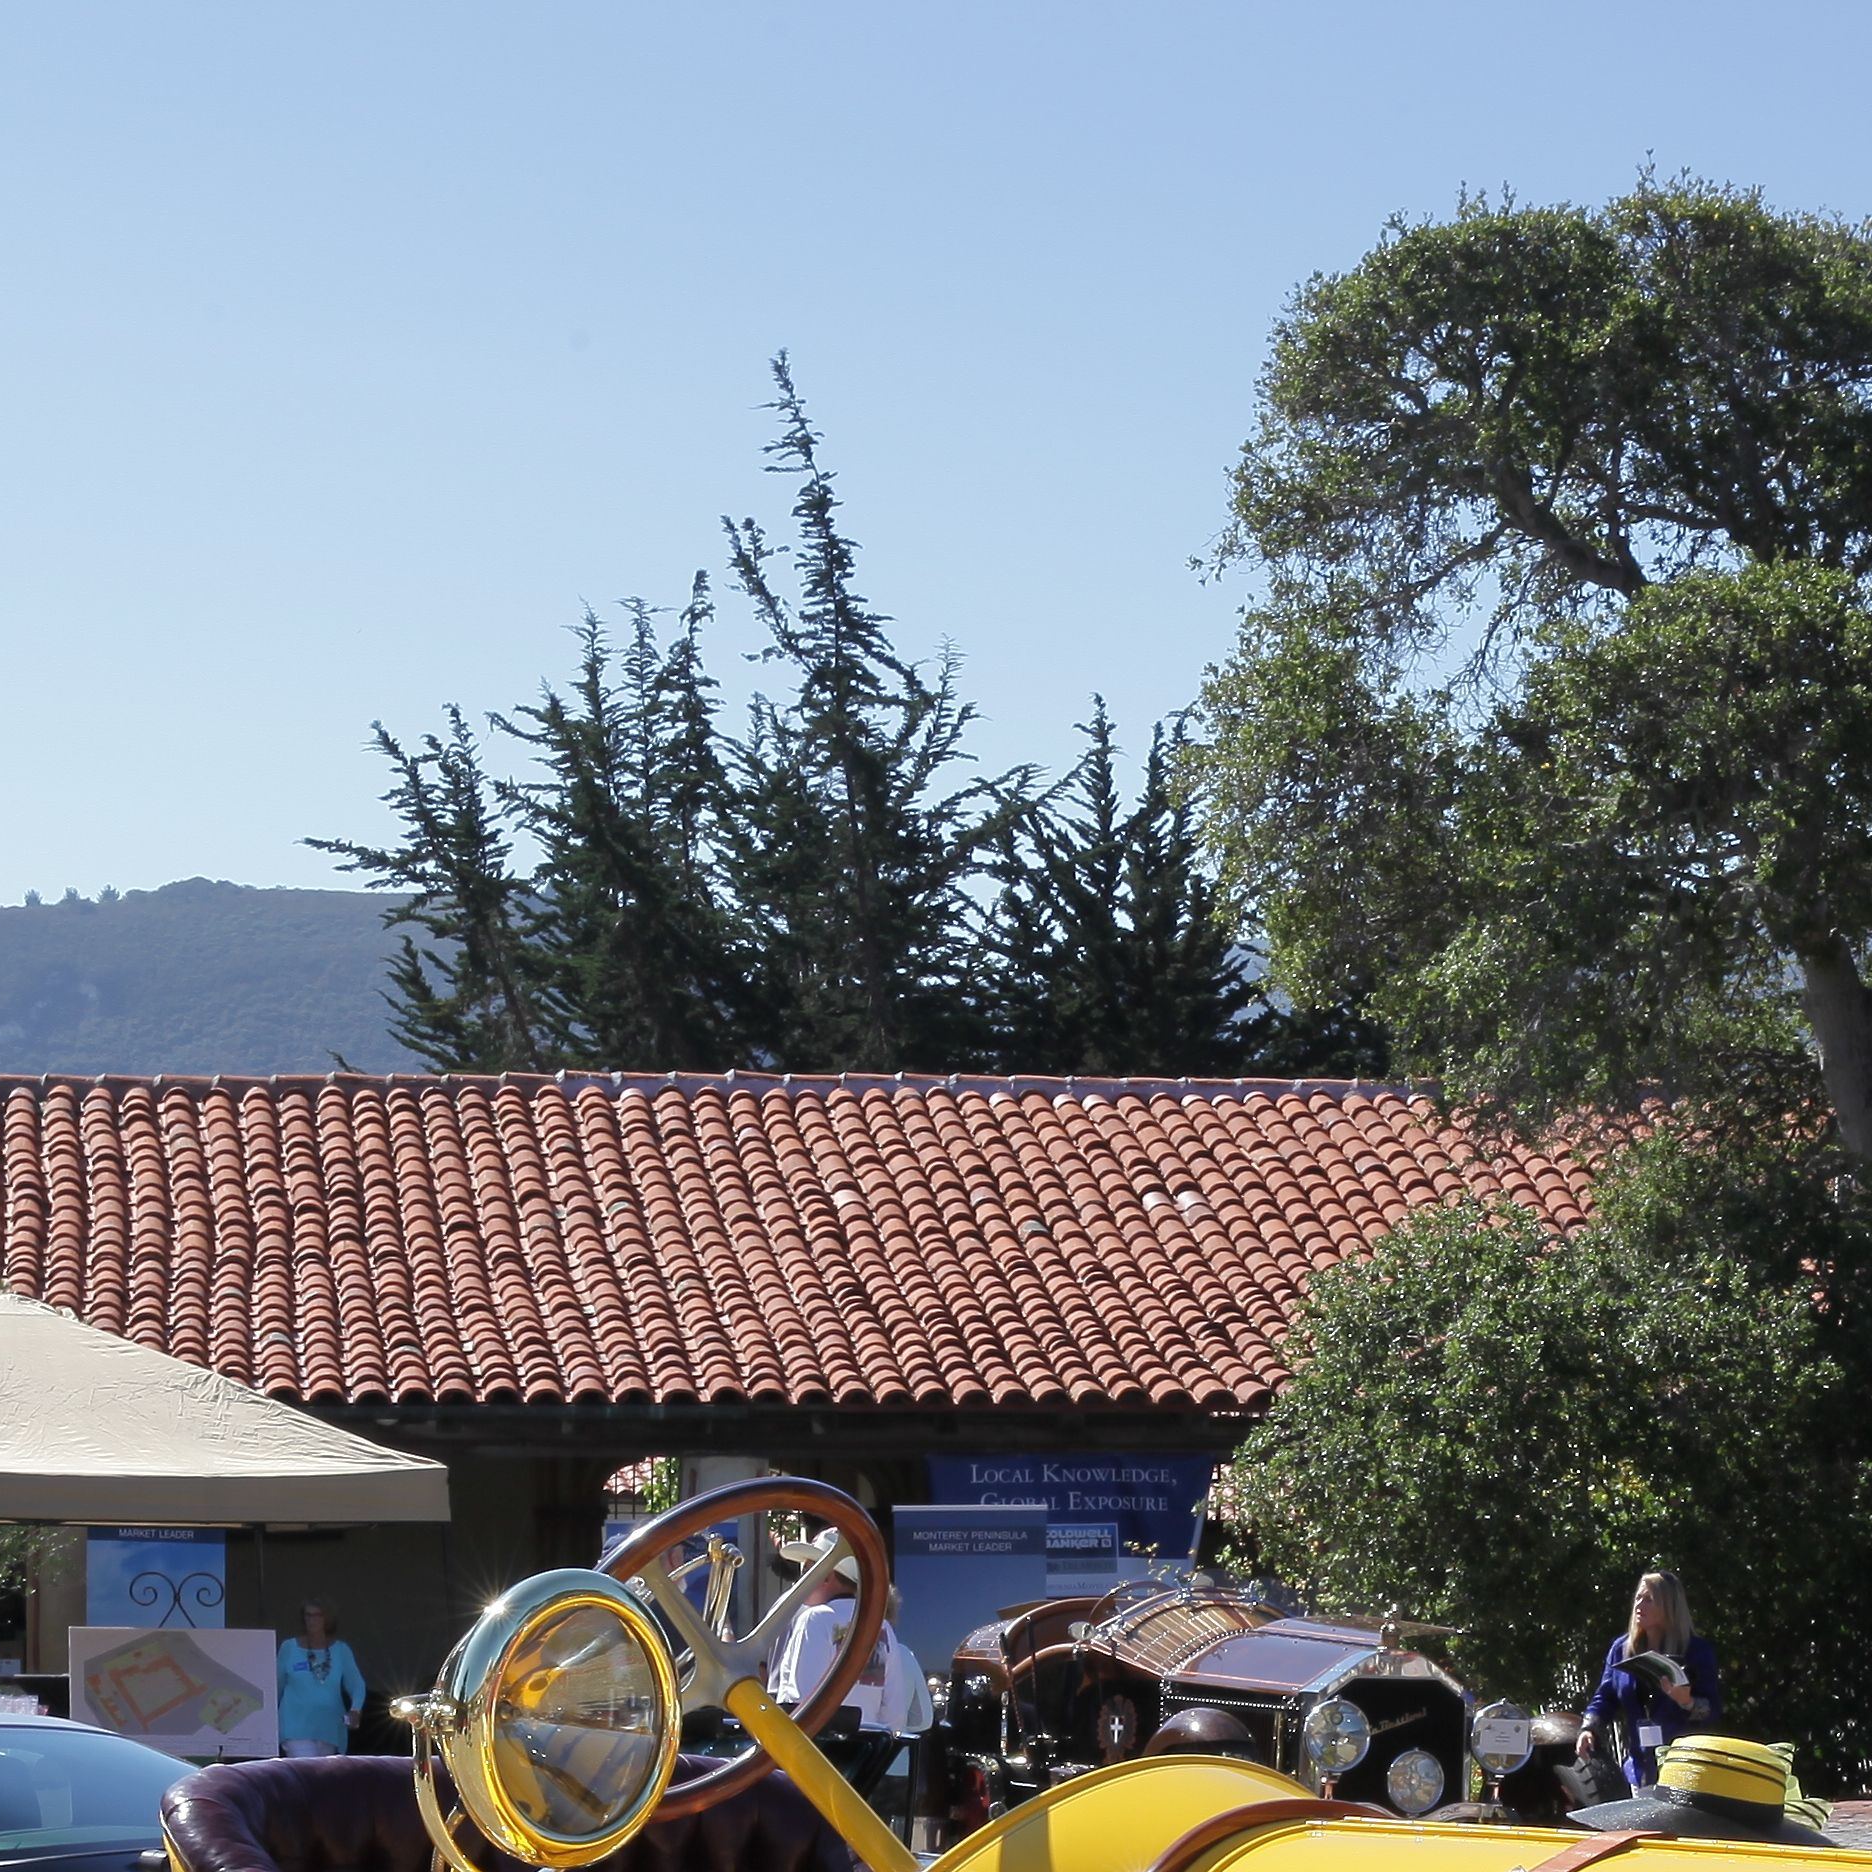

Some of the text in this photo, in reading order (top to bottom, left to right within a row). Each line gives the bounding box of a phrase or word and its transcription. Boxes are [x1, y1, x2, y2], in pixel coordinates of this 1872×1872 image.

[970, 1463, 1177, 1487] LOCAL KNOWLEDGE,
[1069, 1491, 1168, 1512] EXPOSURE
[118, 1529, 194, 1540] MARKET LEADER
[913, 1530, 1028, 1540] MONTEREY PENINSULA
[928, 1542, 1012, 1552] MARKET LEADER
